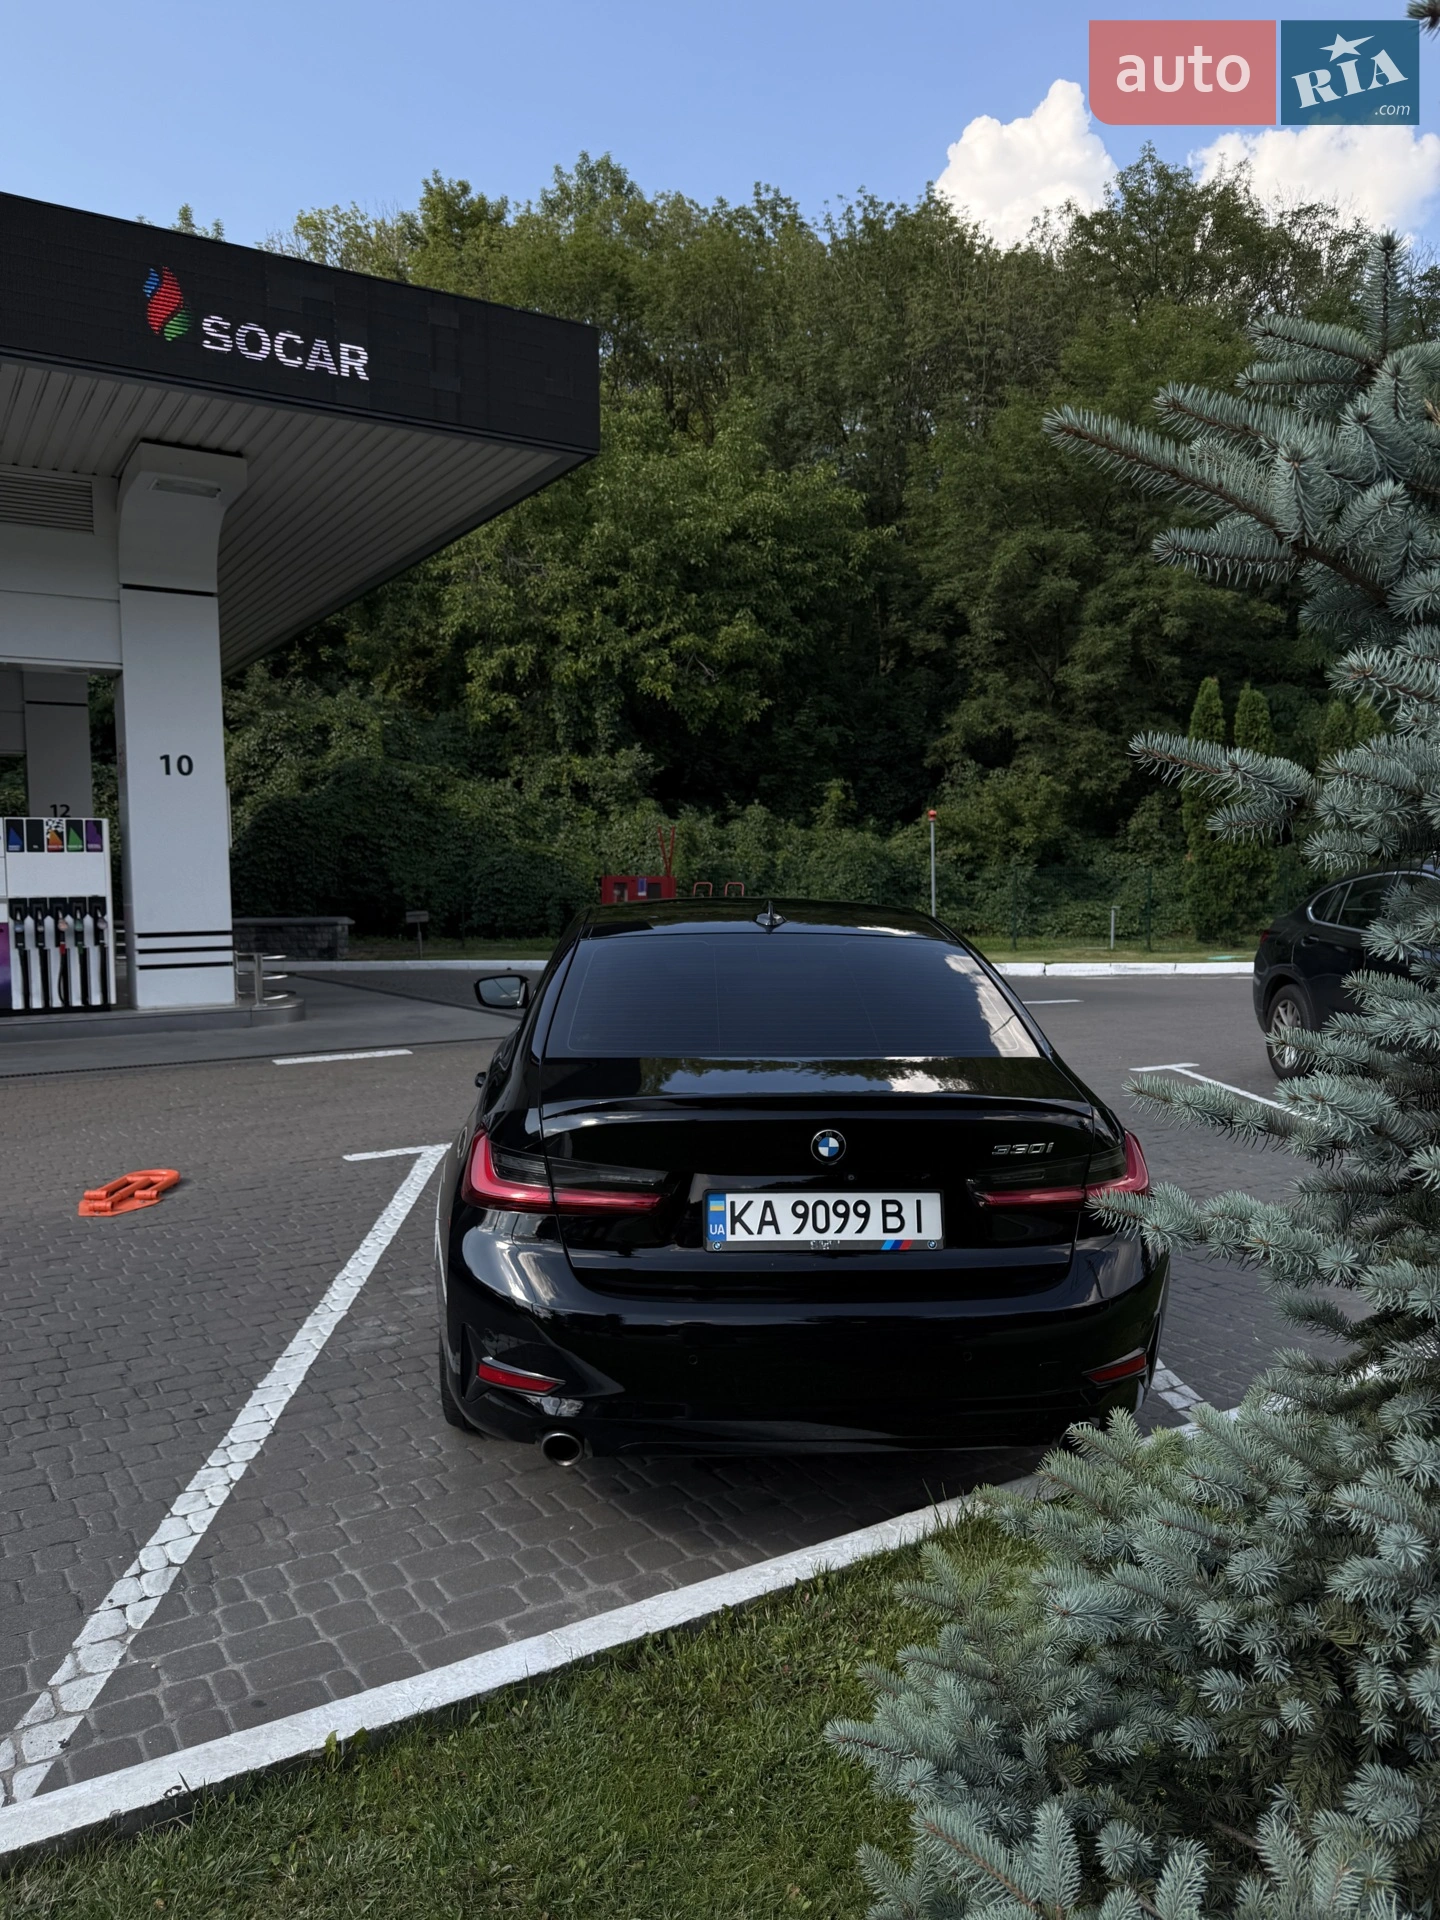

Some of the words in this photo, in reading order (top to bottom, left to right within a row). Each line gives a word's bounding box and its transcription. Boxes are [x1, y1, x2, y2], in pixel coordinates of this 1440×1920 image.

[202, 315, 370, 381] SOCAR
[159, 754, 194, 777] 10
[50, 803, 71, 817] 12
[991, 1142, 1055, 1155] 330i
[729, 1200, 782, 1236] KA
[790, 1199, 871, 1235] 9099
[881, 1199, 923, 1234] BI
[709, 1224, 726, 1236] UA
